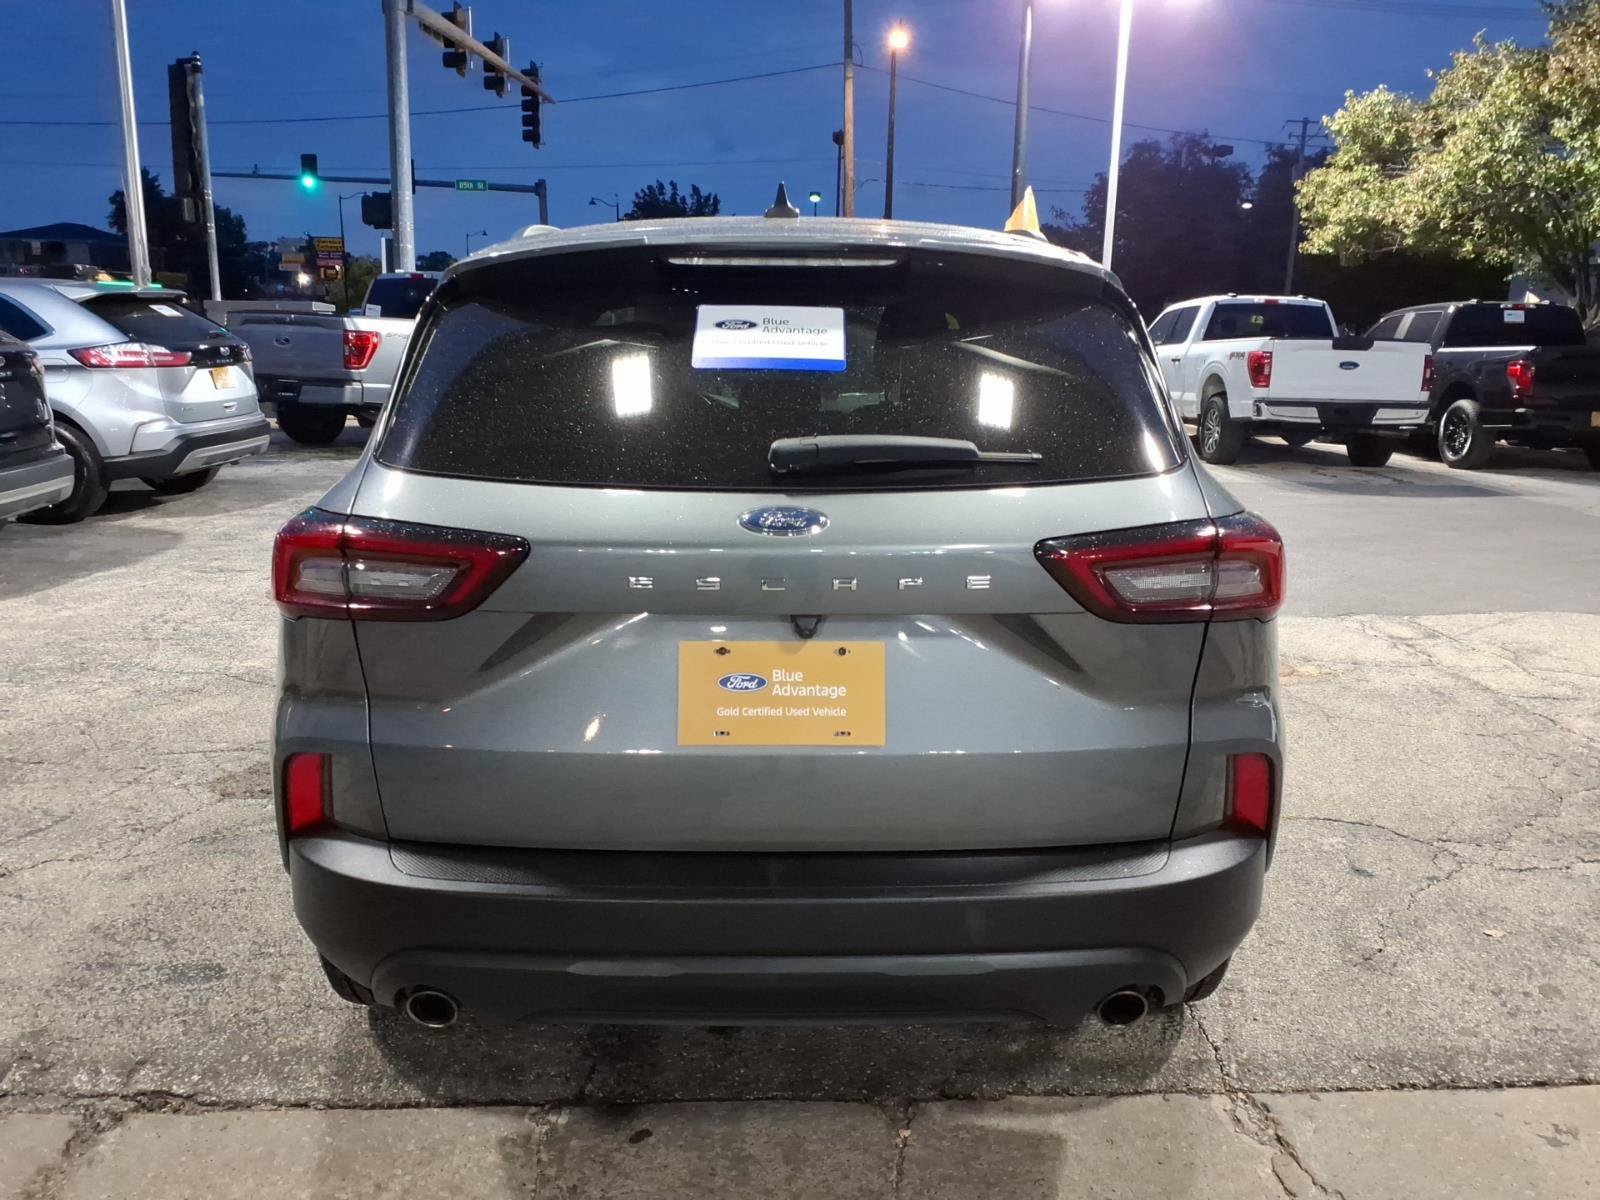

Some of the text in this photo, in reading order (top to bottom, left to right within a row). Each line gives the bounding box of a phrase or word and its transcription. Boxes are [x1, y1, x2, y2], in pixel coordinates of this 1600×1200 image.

[762, 317, 790, 326] Blue
[762, 327, 828, 335] Advantage
[628, 574, 992, 592] ESCAPE
[727, 675, 759, 689] Ford
[772, 669, 804, 682] Blue
[772, 684, 848, 699] Advantage
[716, 706, 847, 717] Gold Certified Used Vehicle
